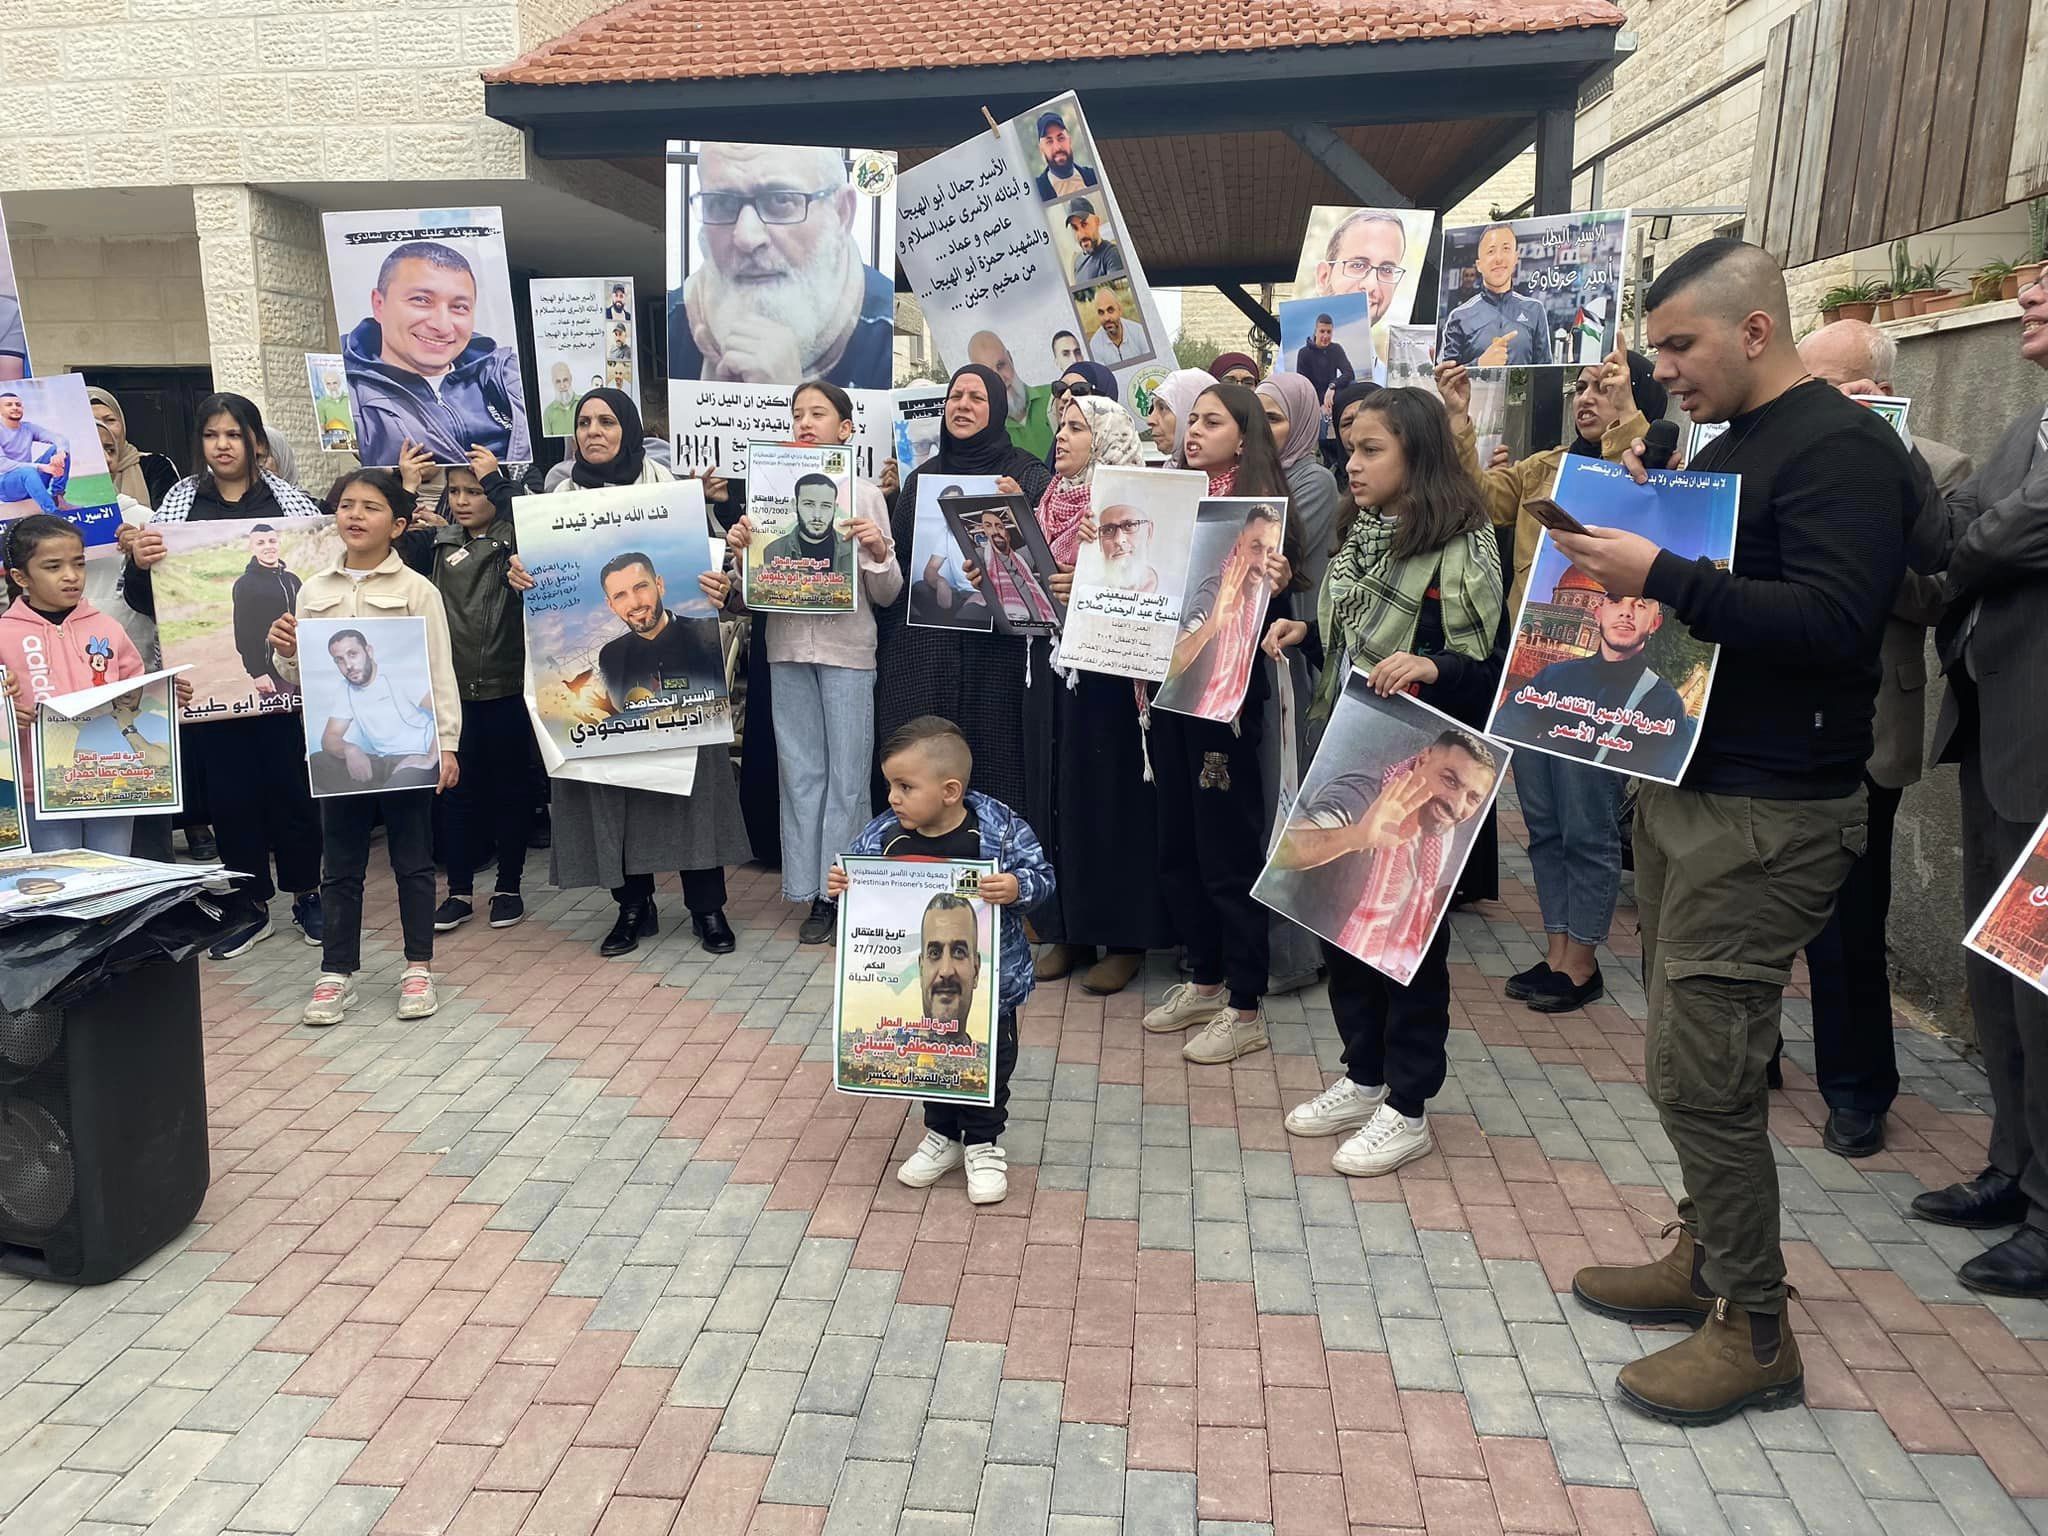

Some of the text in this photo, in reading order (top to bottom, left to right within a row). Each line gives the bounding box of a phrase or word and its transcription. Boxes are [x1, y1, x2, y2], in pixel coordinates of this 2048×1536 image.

[898, 158, 1008, 221] الأسير جمال أبو الهيجا
[994, 177, 1021, 202] أبنائه
[1023, 181, 1030, 195] و
[959, 195, 993, 224] الأسرى
[983, 217, 1012, 245] عاصم
[1542, 224, 1606, 248] الاسير البطل
[899, 240, 906, 254] و
[949, 237, 972, 255] عماد
[974, 234, 981, 248] و
[1008, 229, 1050, 258] والشهيد
[965, 256, 977, 281] أبو
[979, 252, 1006, 272] حمزة
[930, 266, 963, 291] الهيجا
[1022, 264, 1037, 281] من
[1528, 256, 1613, 293] أمير عرقاوي
[992, 274, 1019, 298] مخيم
[965, 287, 989, 308] جنين
[696, 393, 716, 405] زائل
[718, 394, 741, 407] الليل
[695, 416, 734, 428] السلاسل
[737, 417, 751, 430] زرد
[732, 460, 746, 472] لاح
[63, 507, 114, 524] الاسير اح
[552, 505, 668, 531] فك الله بالعز قيدك
[752, 506, 788, 515] 12/10/2002
[1140, 595, 1168, 607] الأسير
[1076, 600, 1180, 622] لشيخ عبد الرحمن صلاح
[22, 635, 56, 702] adida
[233, 695, 254, 713] ابو
[259, 694, 289, 712] زهير
[682, 687, 715, 707] الأسير
[1515, 685, 1557, 710] البطل
[1556, 696, 1595, 718] القائد
[656, 705, 703, 734] أديب
[1633, 711, 1675, 735] الحرية
[570, 718, 650, 748] سمودي
[1549, 720, 1632, 752] محمد الأسمر
[65, 769, 96, 783] حمدان
[121, 766, 154, 779] يوسف
[852, 868, 889, 876] الفلسطيني
[909, 871, 926, 879] نادي
[926, 871, 949, 880] جمعية
[852, 879, 949, 891] Palestinian Prisoner's Society
[851, 926, 906, 942] تاريخ الاعتقال
[854, 943, 902, 956] 27/7/2003
[864, 961, 886, 972] الحكم
[848, 972, 899, 984] مدى الحياة
[876, 1015, 902, 1031] البطل
[933, 1019, 959, 1034] الحرية
[898, 1036, 947, 1057] مصطفى
